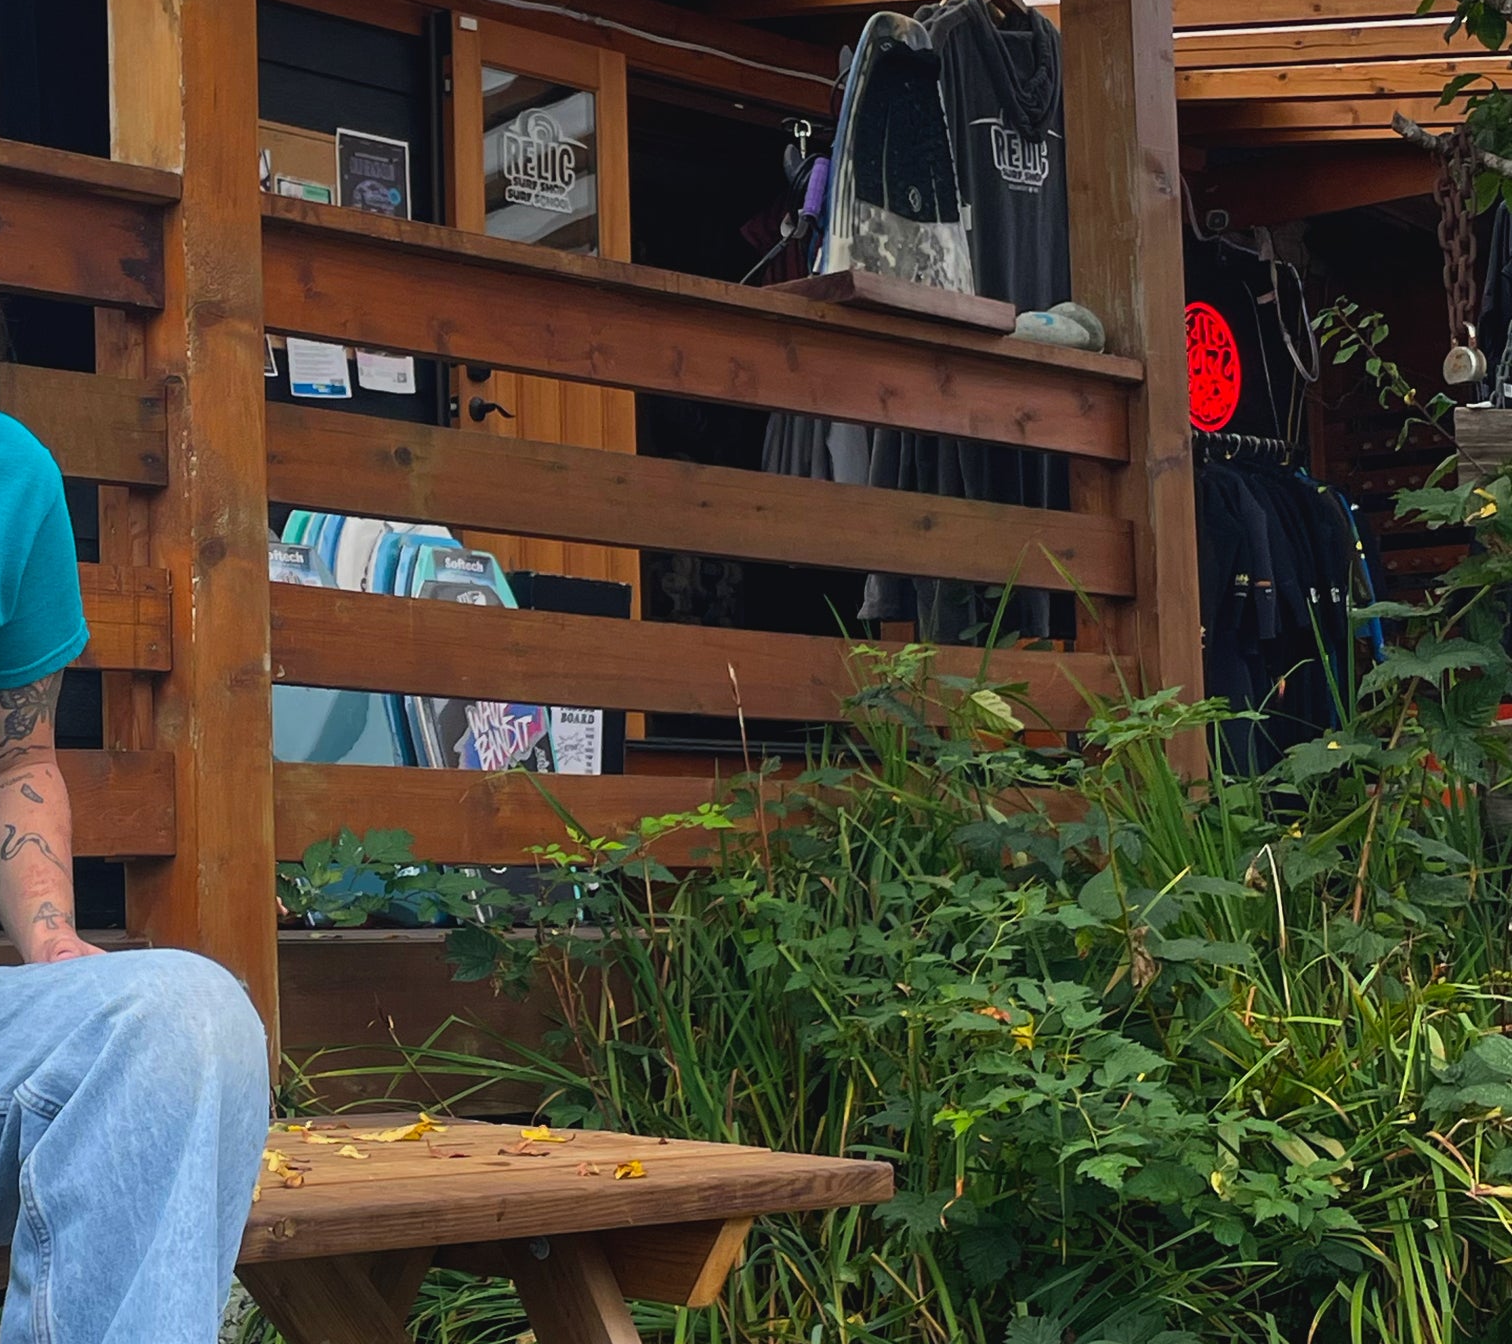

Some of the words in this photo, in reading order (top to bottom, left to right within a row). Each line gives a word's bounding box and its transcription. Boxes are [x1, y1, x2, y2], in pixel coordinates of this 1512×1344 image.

[503, 132, 575, 188] RELIC
[512, 176, 538, 190] SURF
[540, 182, 567, 195] SHOP
[507, 189, 532, 203] SURF
[444, 557, 484, 573] Softech
[561, 712, 595, 724] BOARD
[474, 714, 533, 771] BANDIT
